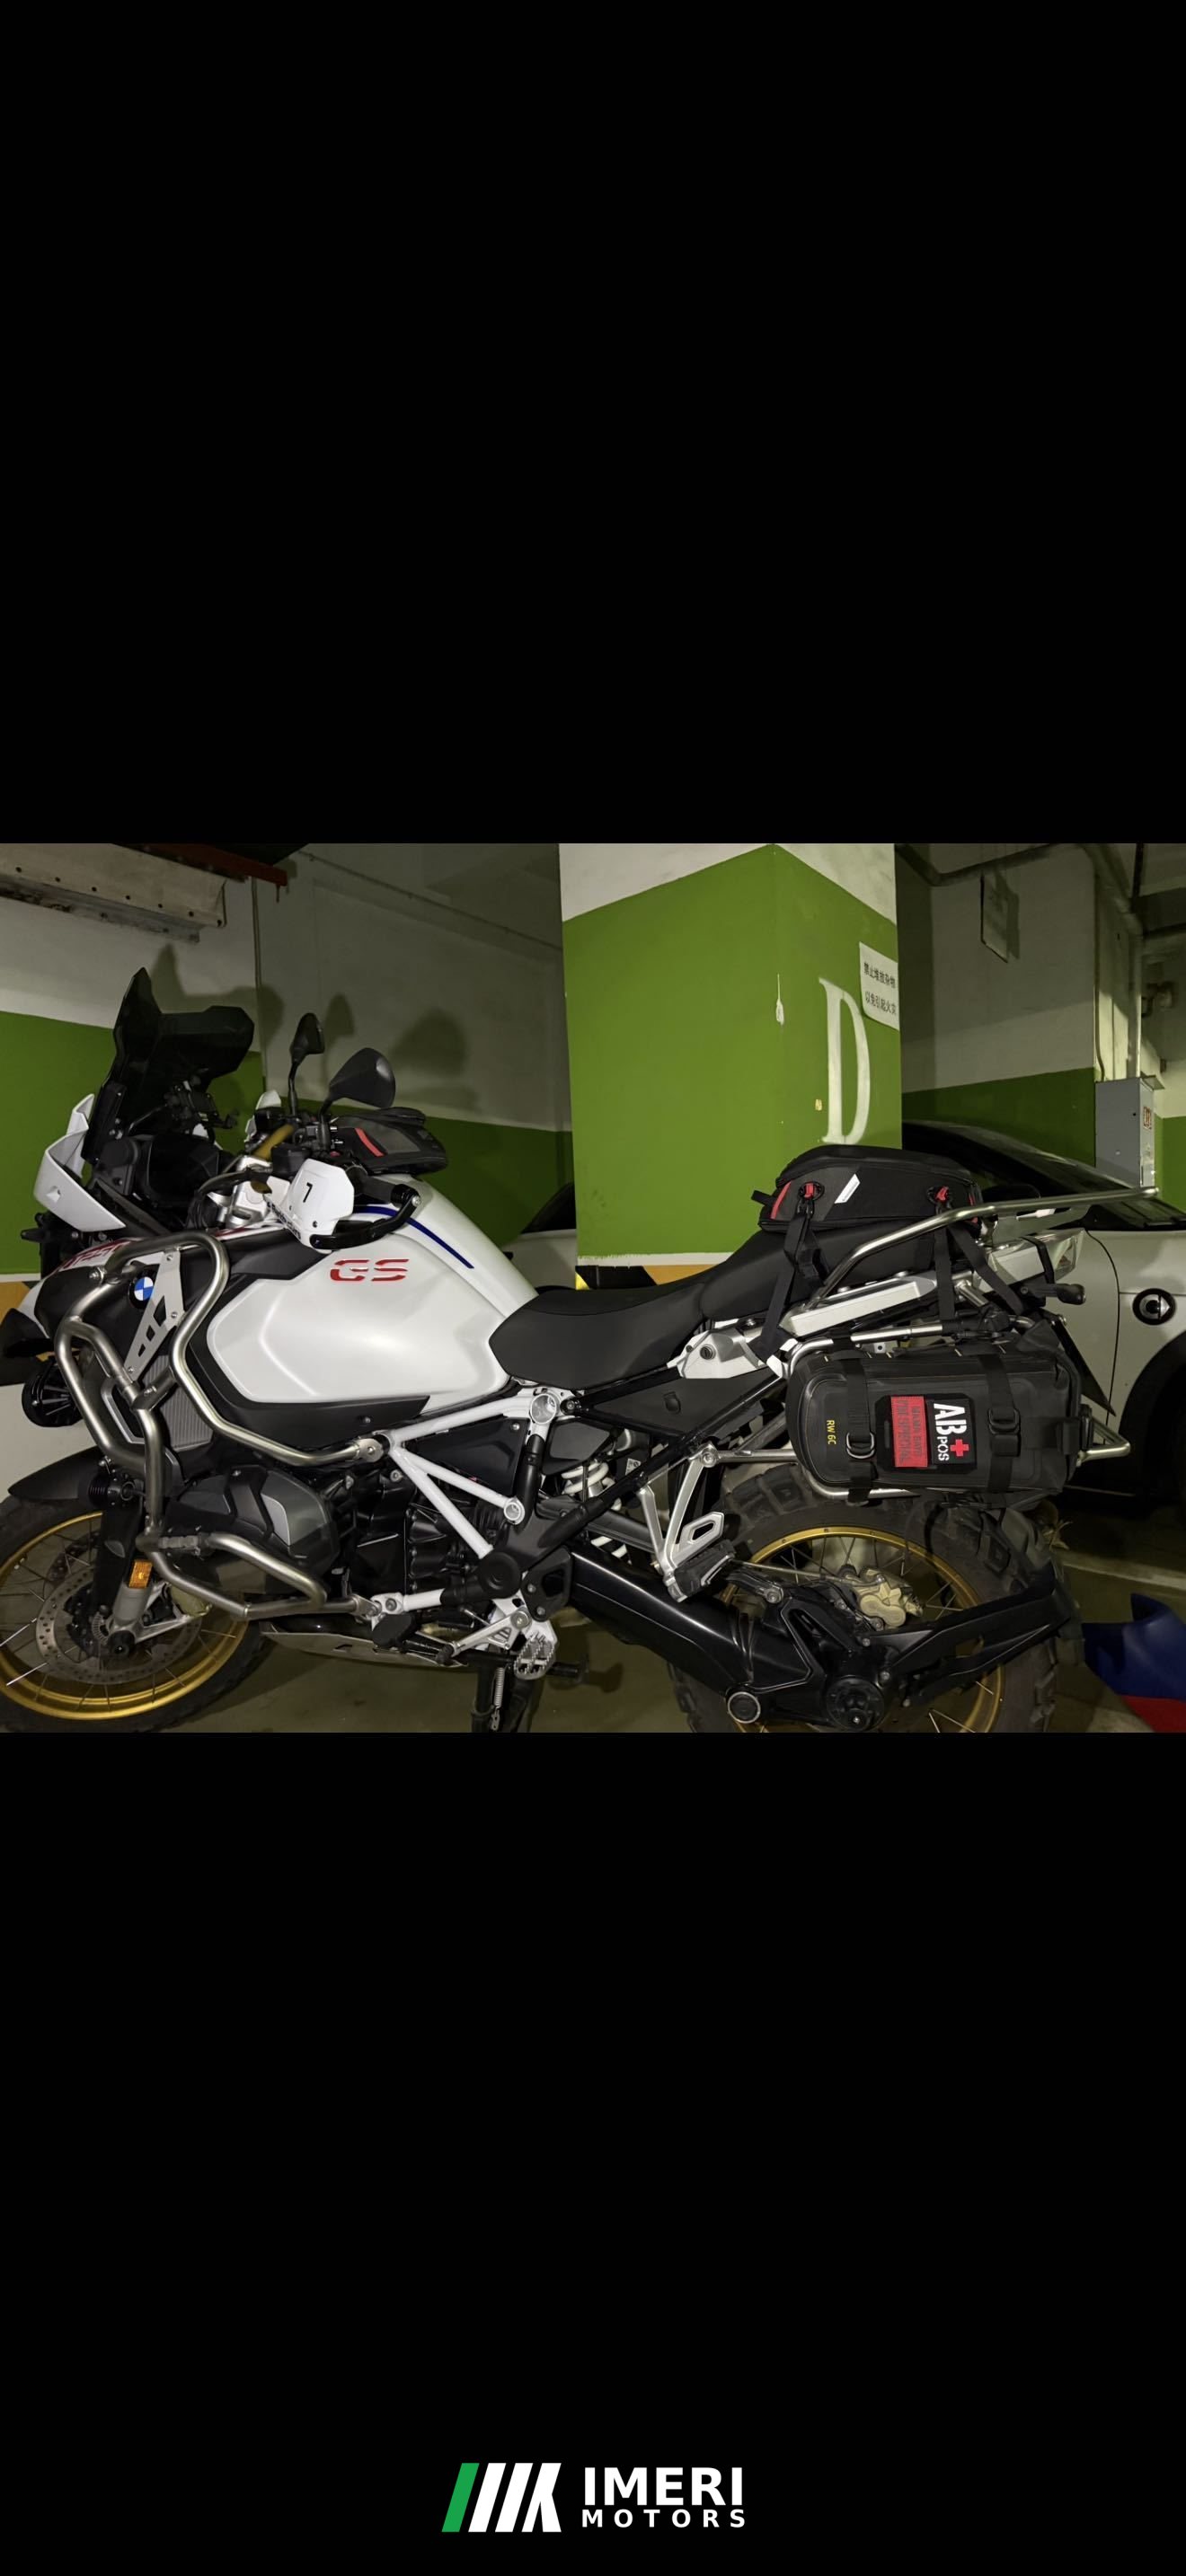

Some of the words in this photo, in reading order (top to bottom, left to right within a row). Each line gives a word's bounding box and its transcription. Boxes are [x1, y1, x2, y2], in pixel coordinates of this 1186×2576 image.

[819, 976, 871, 1145] D
[303, 1182, 313, 1203] 7
[330, 1258, 410, 1282] GS
[826, 1419, 836, 1434] RW
[933, 1403, 968, 1435] AB
[827, 1434, 836, 1445] 6C
[937, 1436, 950, 1461] POS
